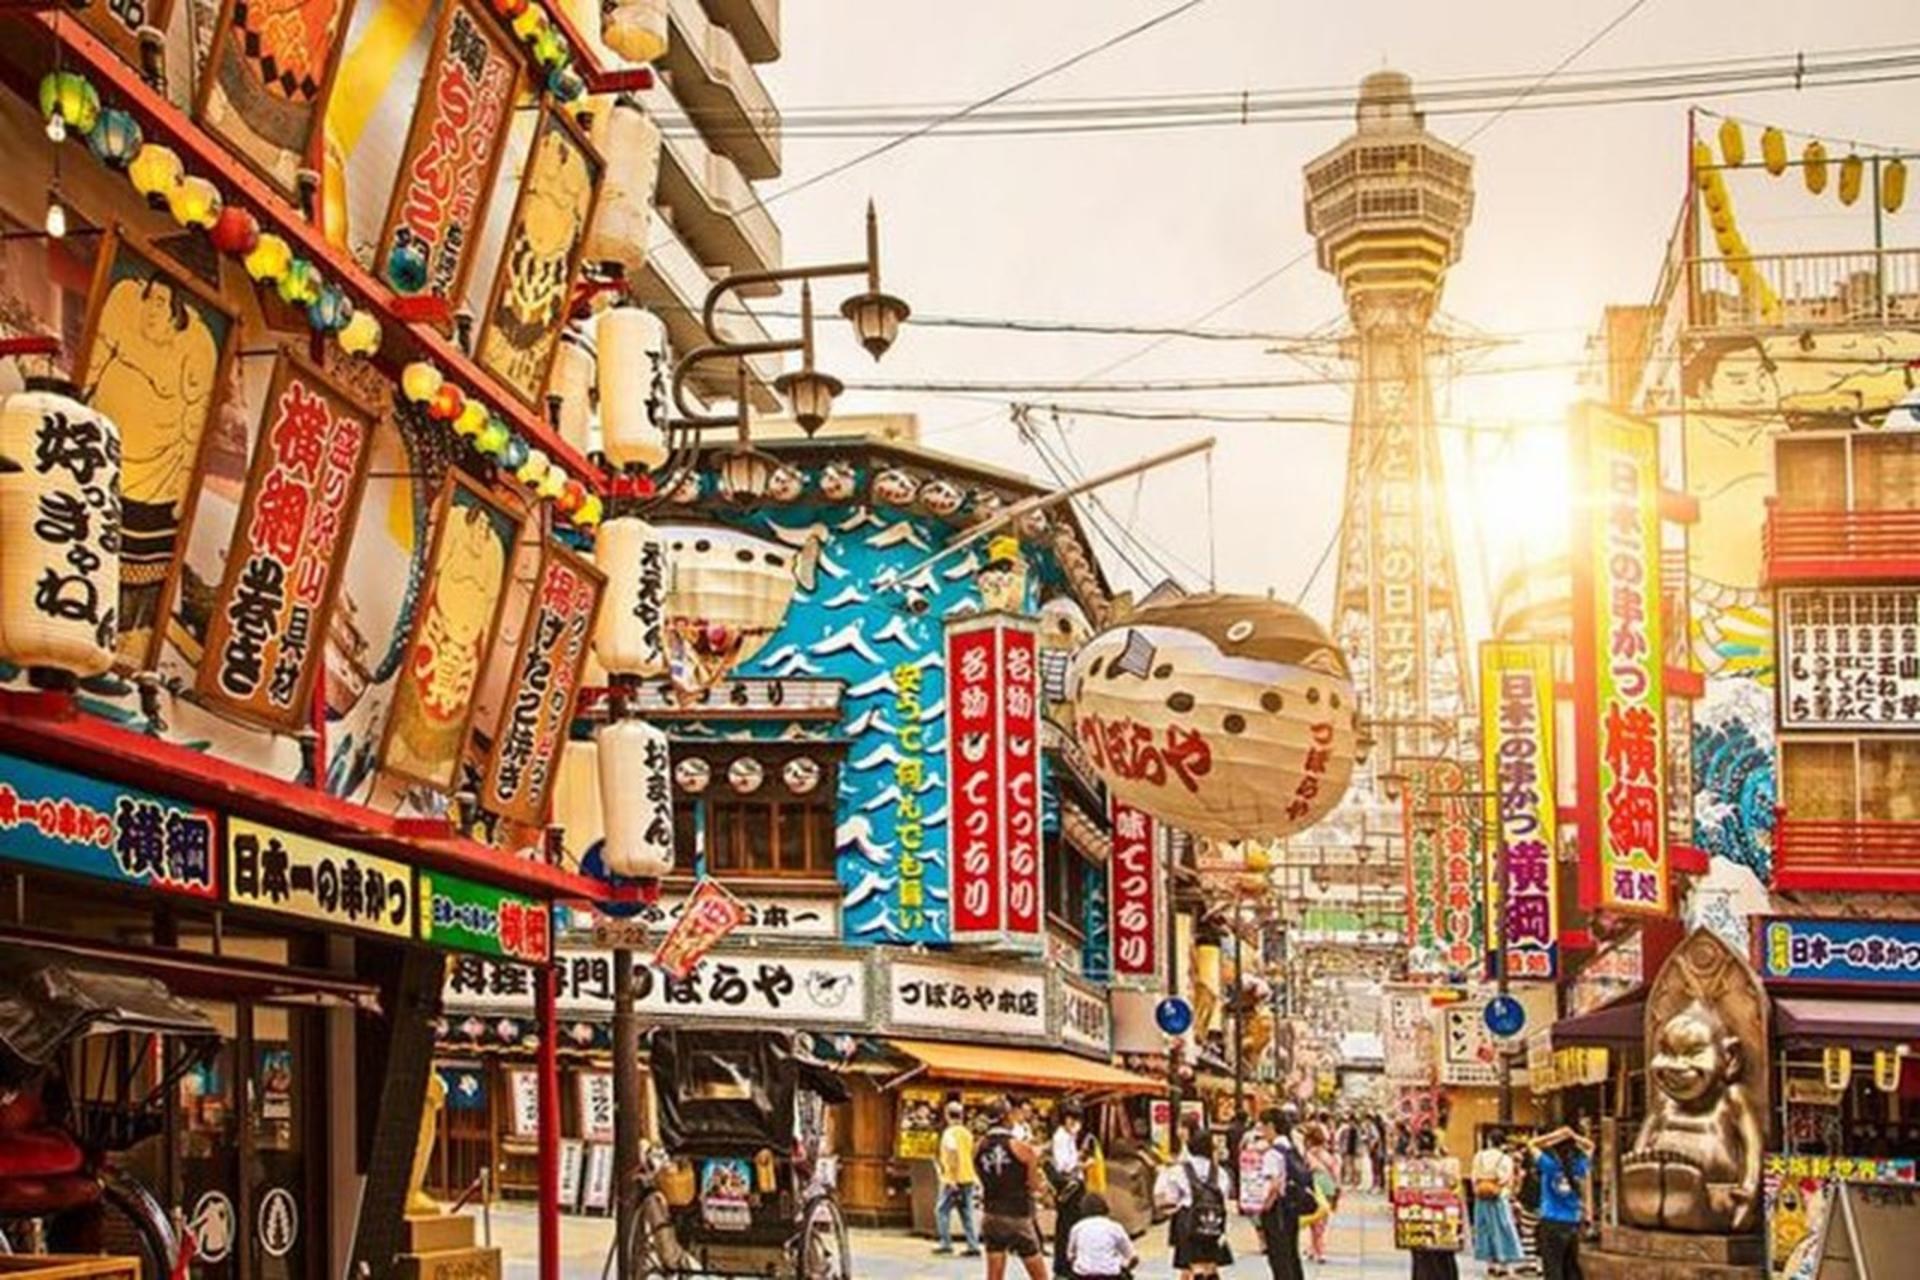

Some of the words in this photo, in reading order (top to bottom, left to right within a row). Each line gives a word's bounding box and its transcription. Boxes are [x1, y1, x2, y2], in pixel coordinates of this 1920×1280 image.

[1607, 459, 1649, 698] 日本一の串かつ
[960, 645, 990, 720] 名物
[1007, 646, 1033, 720] 名物
[1792, 655, 1810, 720] もち
[1856, 656, 1875, 720] にんにく
[1877, 656, 1898, 720] 玉ねぎ
[1499, 673, 1541, 837] 日本一の串かつ
[1601, 700, 1661, 864] 横綱
[114, 796, 215, 894] 横綱
[232, 832, 409, 926] 日本一の串かつ
[962, 770, 990, 918] てっちり
[1008, 771, 1036, 919] てっちり
[497, 897, 551, 962] 横綱
[1791, 935, 1920, 970] 日本一の串かつ
[899, 978, 1039, 1018] づぼらや本店
